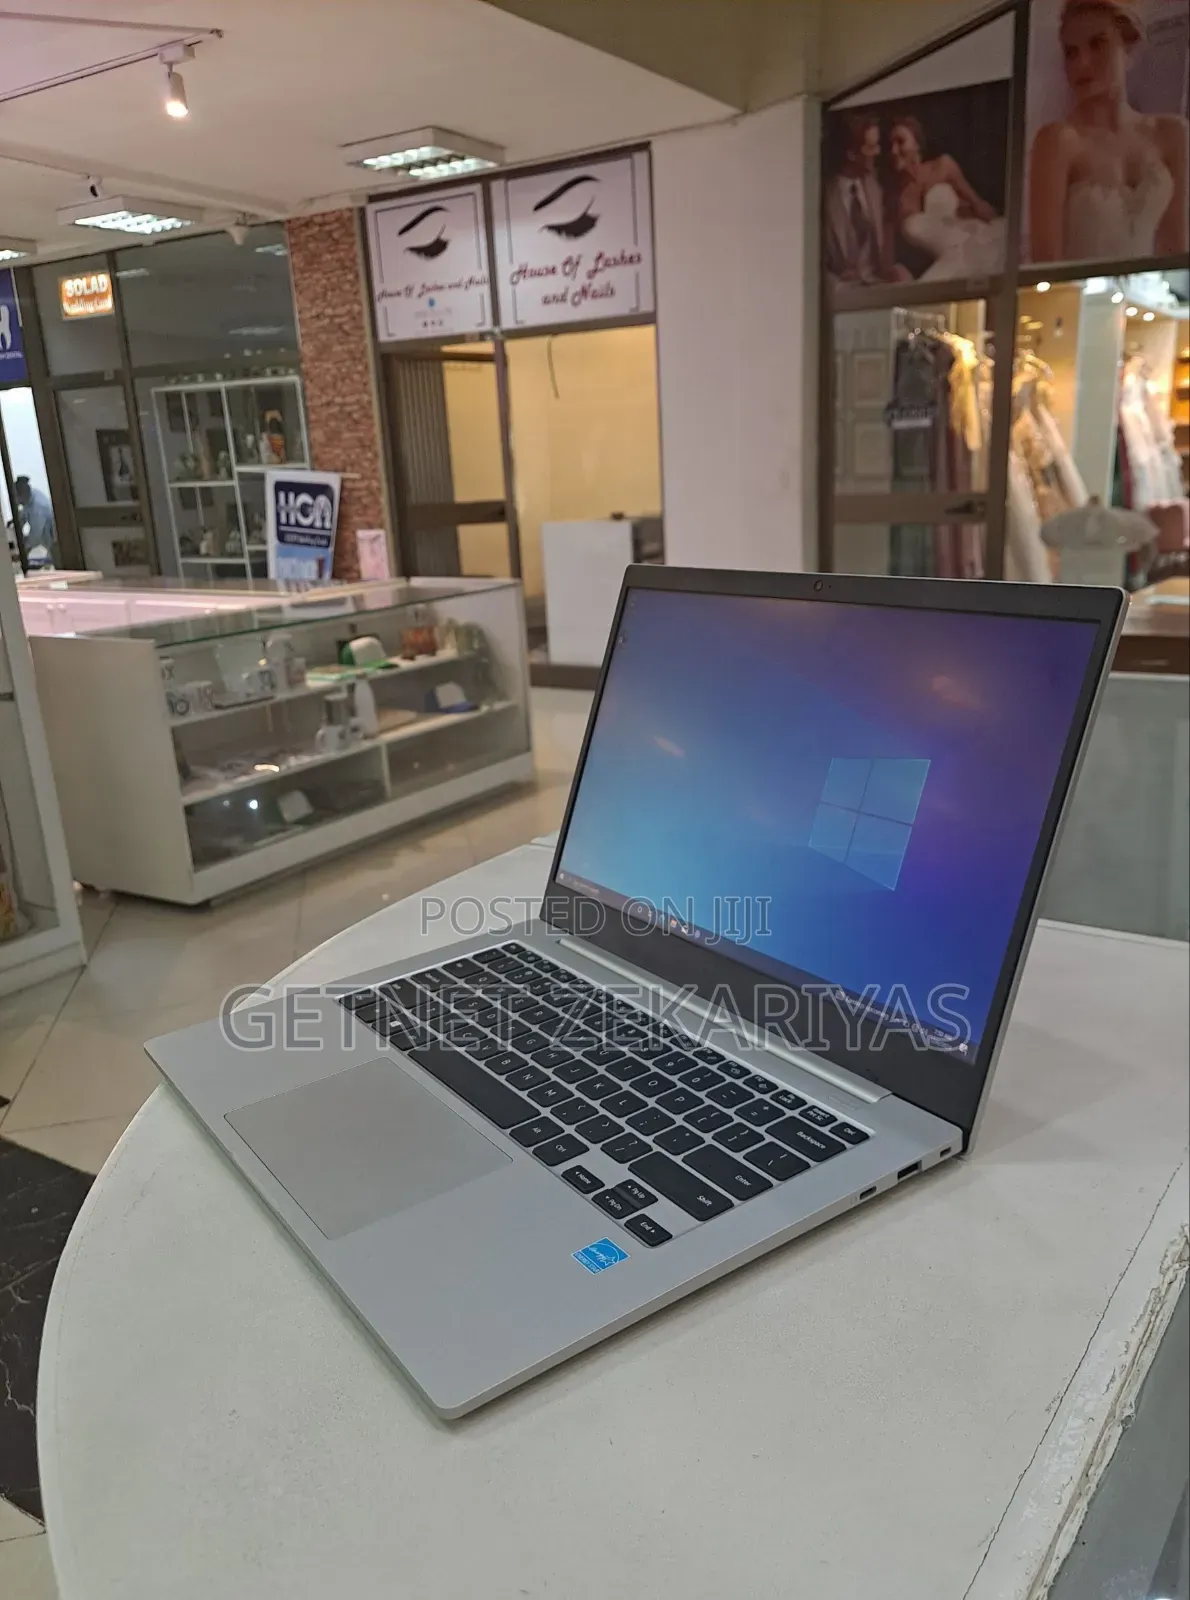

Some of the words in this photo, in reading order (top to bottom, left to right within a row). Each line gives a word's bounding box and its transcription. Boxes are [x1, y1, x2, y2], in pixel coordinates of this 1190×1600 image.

[509, 262, 557, 286] House
[561, 253, 582, 281] Of
[586, 249, 642, 280] Lashes
[541, 284, 569, 306] and
[570, 280, 616, 307] Nails
[522, 1073, 533, 1081] N
[544, 1089, 557, 1097] M
[532, 1126, 542, 1134] Alt
[843, 1127, 856, 1136] Del
[796, 1131, 826, 1149] Backspace
[555, 1144, 567, 1153] Ctrl
[577, 1173, 592, 1184] Home
[734, 1175, 752, 1187] Enter
[696, 1195, 713, 1207] Shift
[640, 1222, 652, 1231] End
